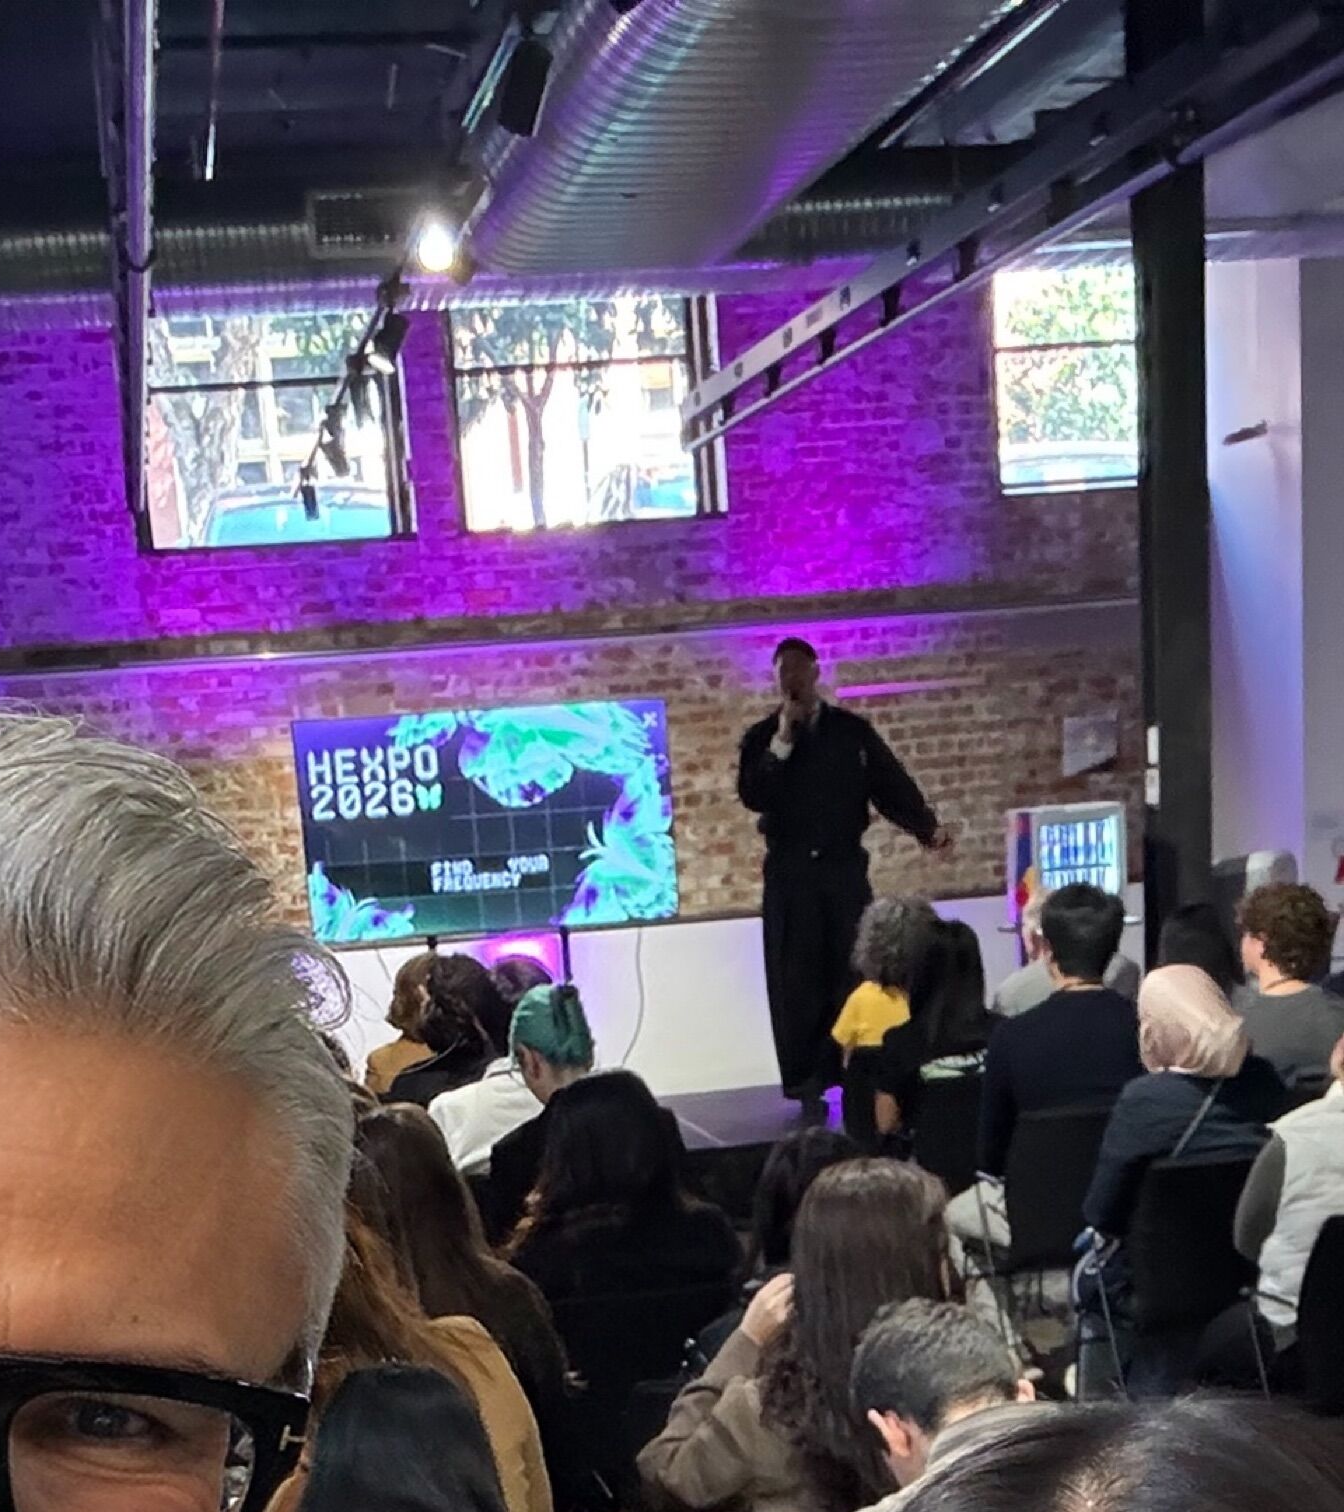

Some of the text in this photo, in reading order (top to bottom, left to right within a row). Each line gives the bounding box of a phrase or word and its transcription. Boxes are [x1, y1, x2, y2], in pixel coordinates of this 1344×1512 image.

[308, 745, 439, 784] HEXPO
[312, 782, 414, 821] 2026
[431, 854, 549, 876] FIND YOUR
[431, 871, 522, 893] FREQUENCY
